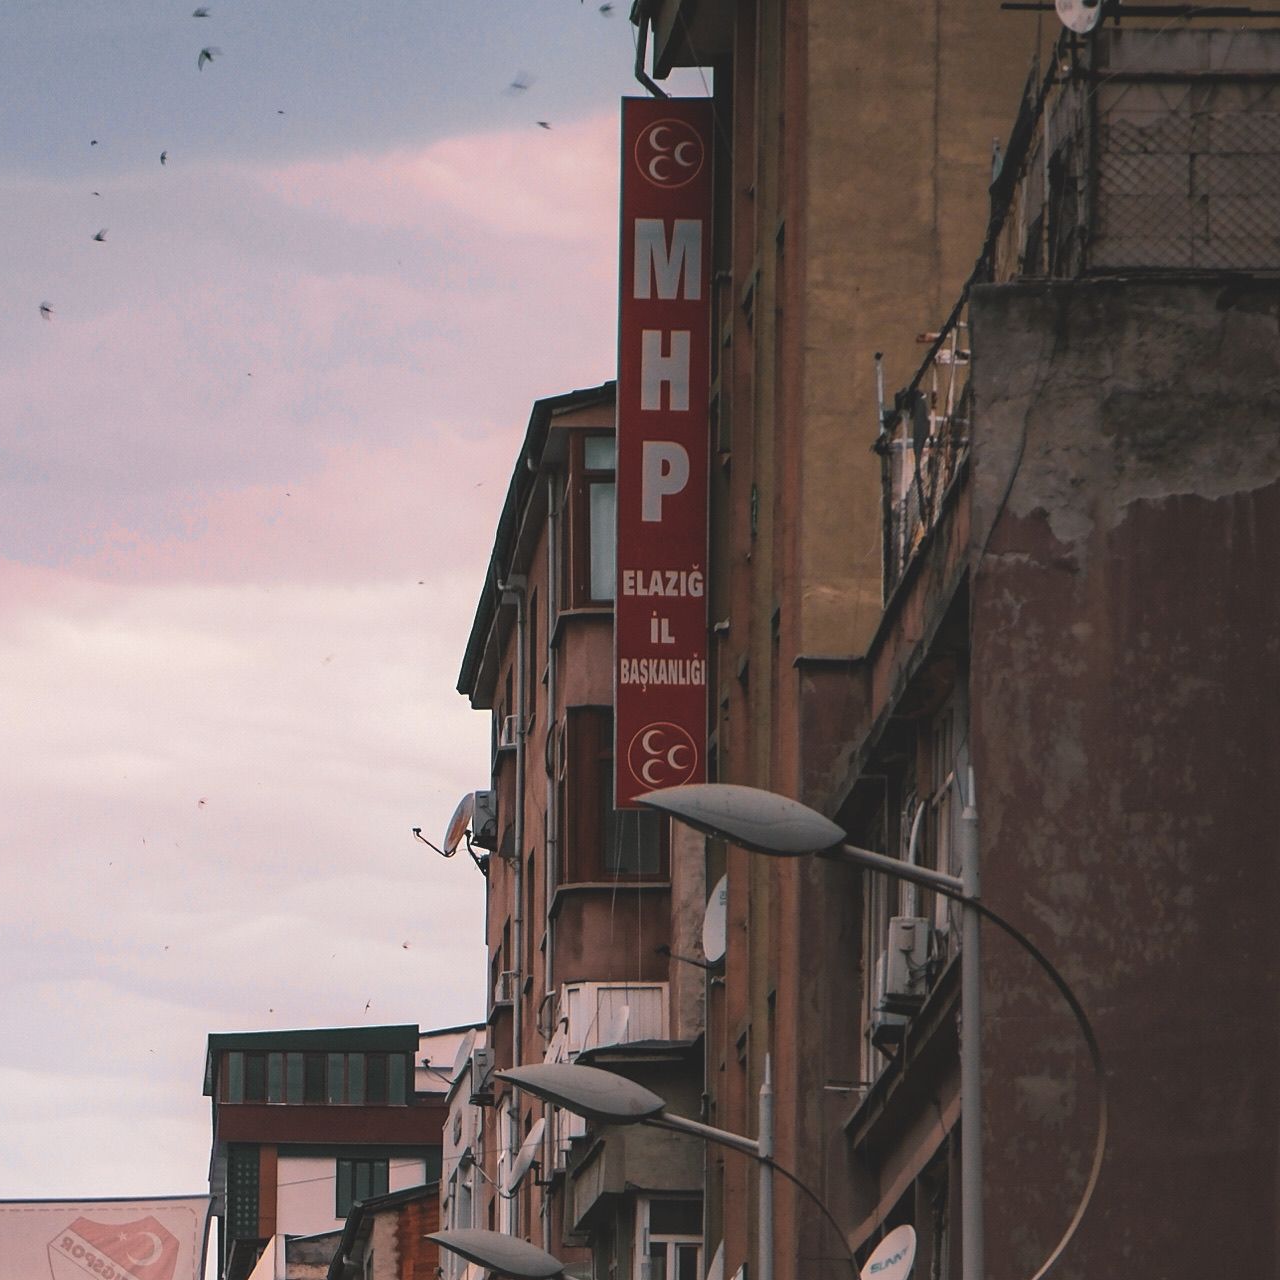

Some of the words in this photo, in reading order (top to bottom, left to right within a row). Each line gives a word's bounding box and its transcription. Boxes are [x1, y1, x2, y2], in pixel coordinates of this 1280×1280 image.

[632, 218, 703, 523] MHP
[622, 563, 704, 600] ELAZIĞ
[650, 609, 676, 645] İL
[619, 651, 706, 694] BAŞKANLIĞI
